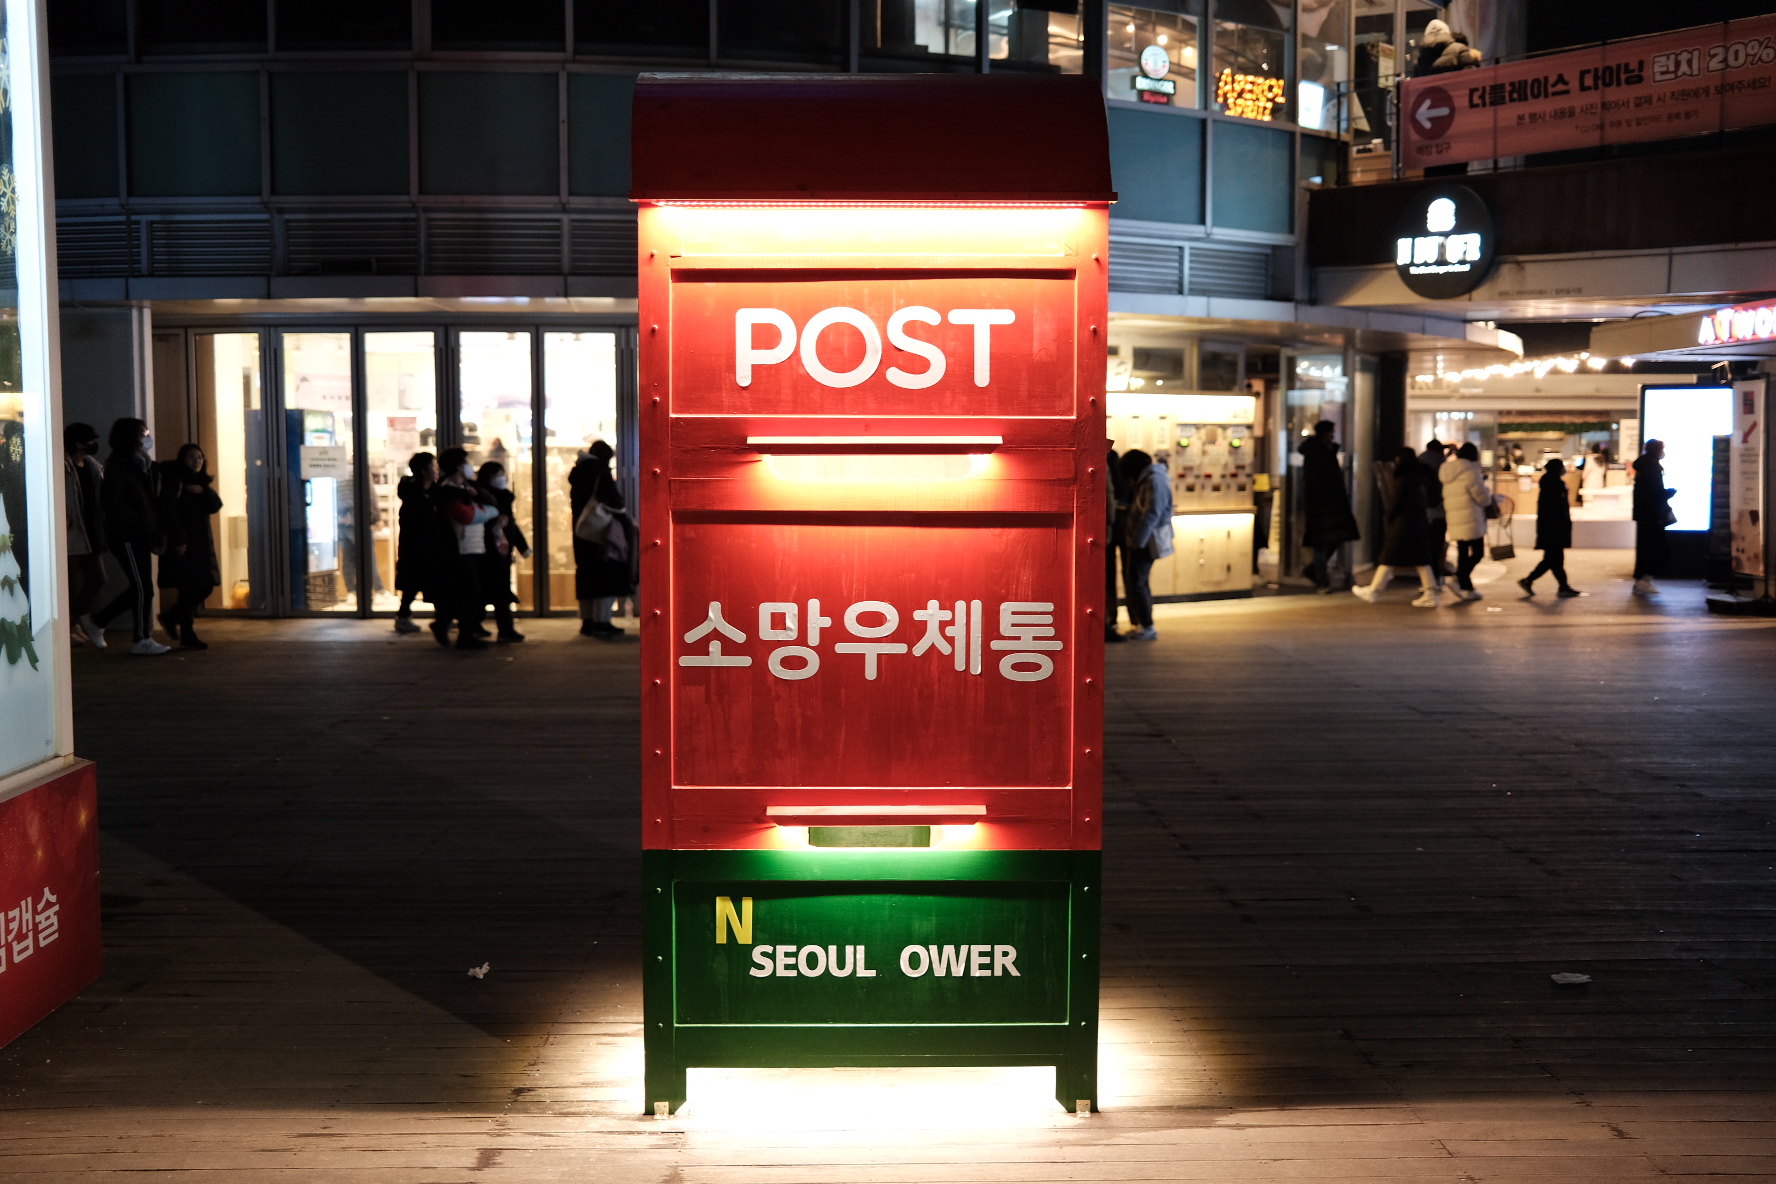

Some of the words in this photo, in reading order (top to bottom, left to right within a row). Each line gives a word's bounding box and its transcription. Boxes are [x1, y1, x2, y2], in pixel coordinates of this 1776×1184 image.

[1468, 73, 1571, 109] 더플레이스
[1579, 60, 1645, 92] 다이닝
[1652, 48, 1701, 83] 런치
[1706, 37, 1776, 73] 20%
[735, 305, 1016, 389] POST
[1716, 305, 1776, 342] TWO
[678, 598, 1064, 682] 소망우체통
[715, 896, 753, 945] N
[749, 944, 877, 978] SEOUL
[900, 944, 1021, 978] OWER
